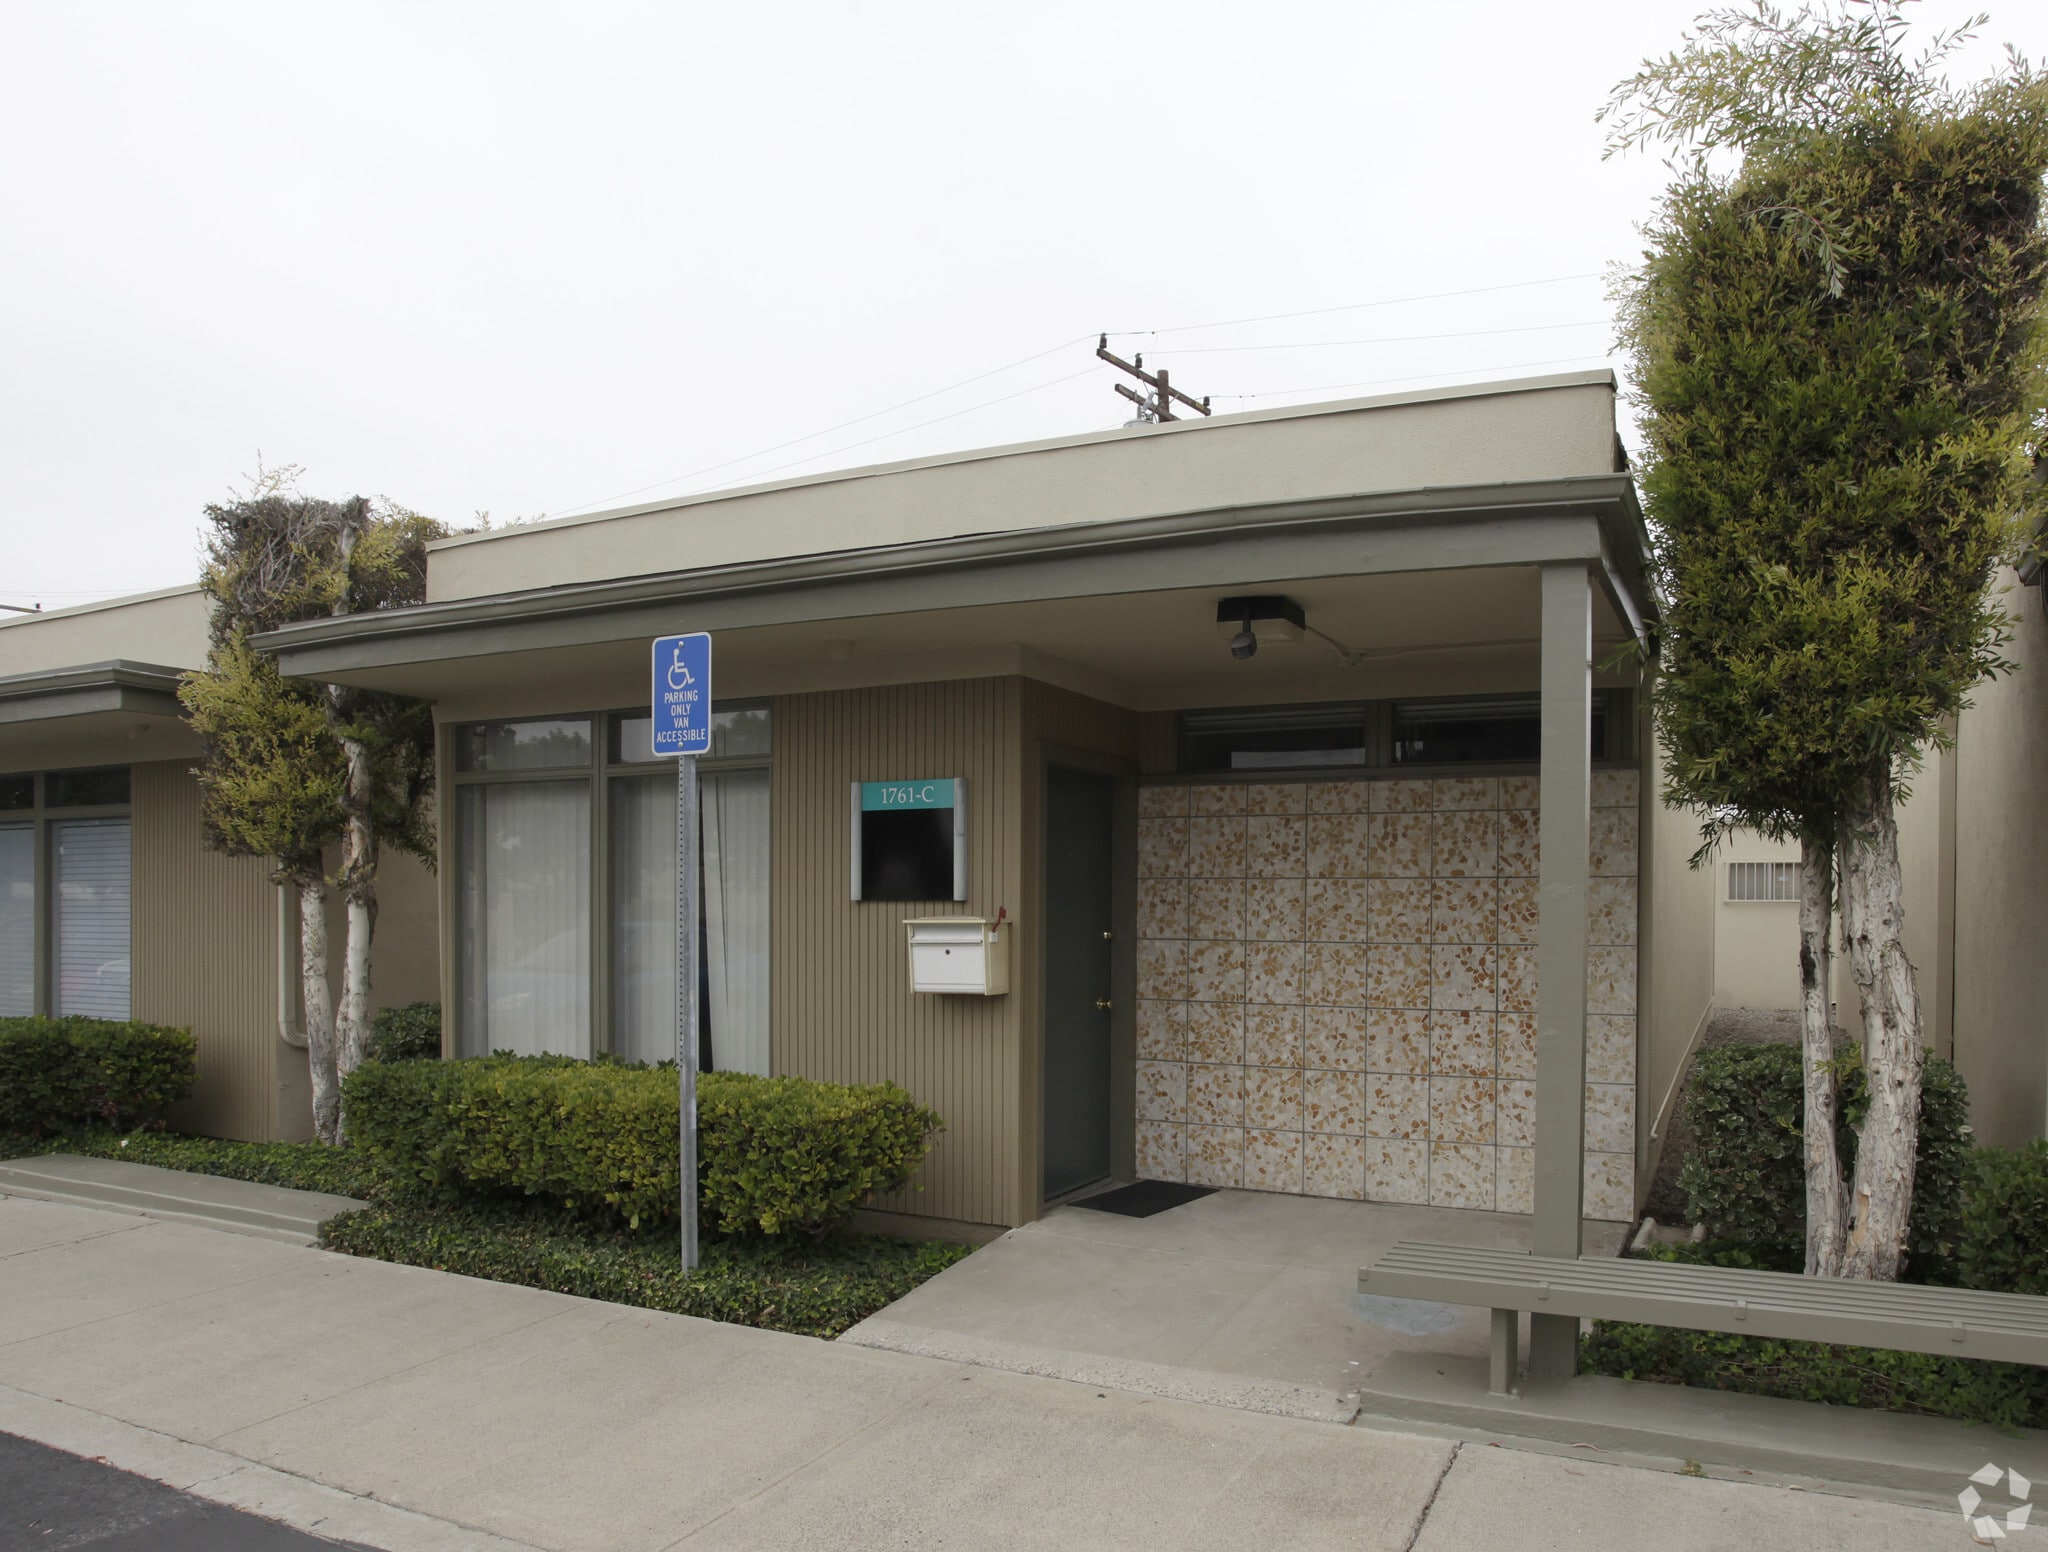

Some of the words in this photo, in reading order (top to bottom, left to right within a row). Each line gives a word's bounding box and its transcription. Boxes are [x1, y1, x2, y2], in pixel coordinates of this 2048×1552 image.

[664, 690, 699, 704] PARKING
[670, 704, 691, 716] ONLY
[673, 717, 689, 729] VAN
[656, 728, 706, 743] ACCESSIBLE
[880, 786, 934, 804] 1761-C
